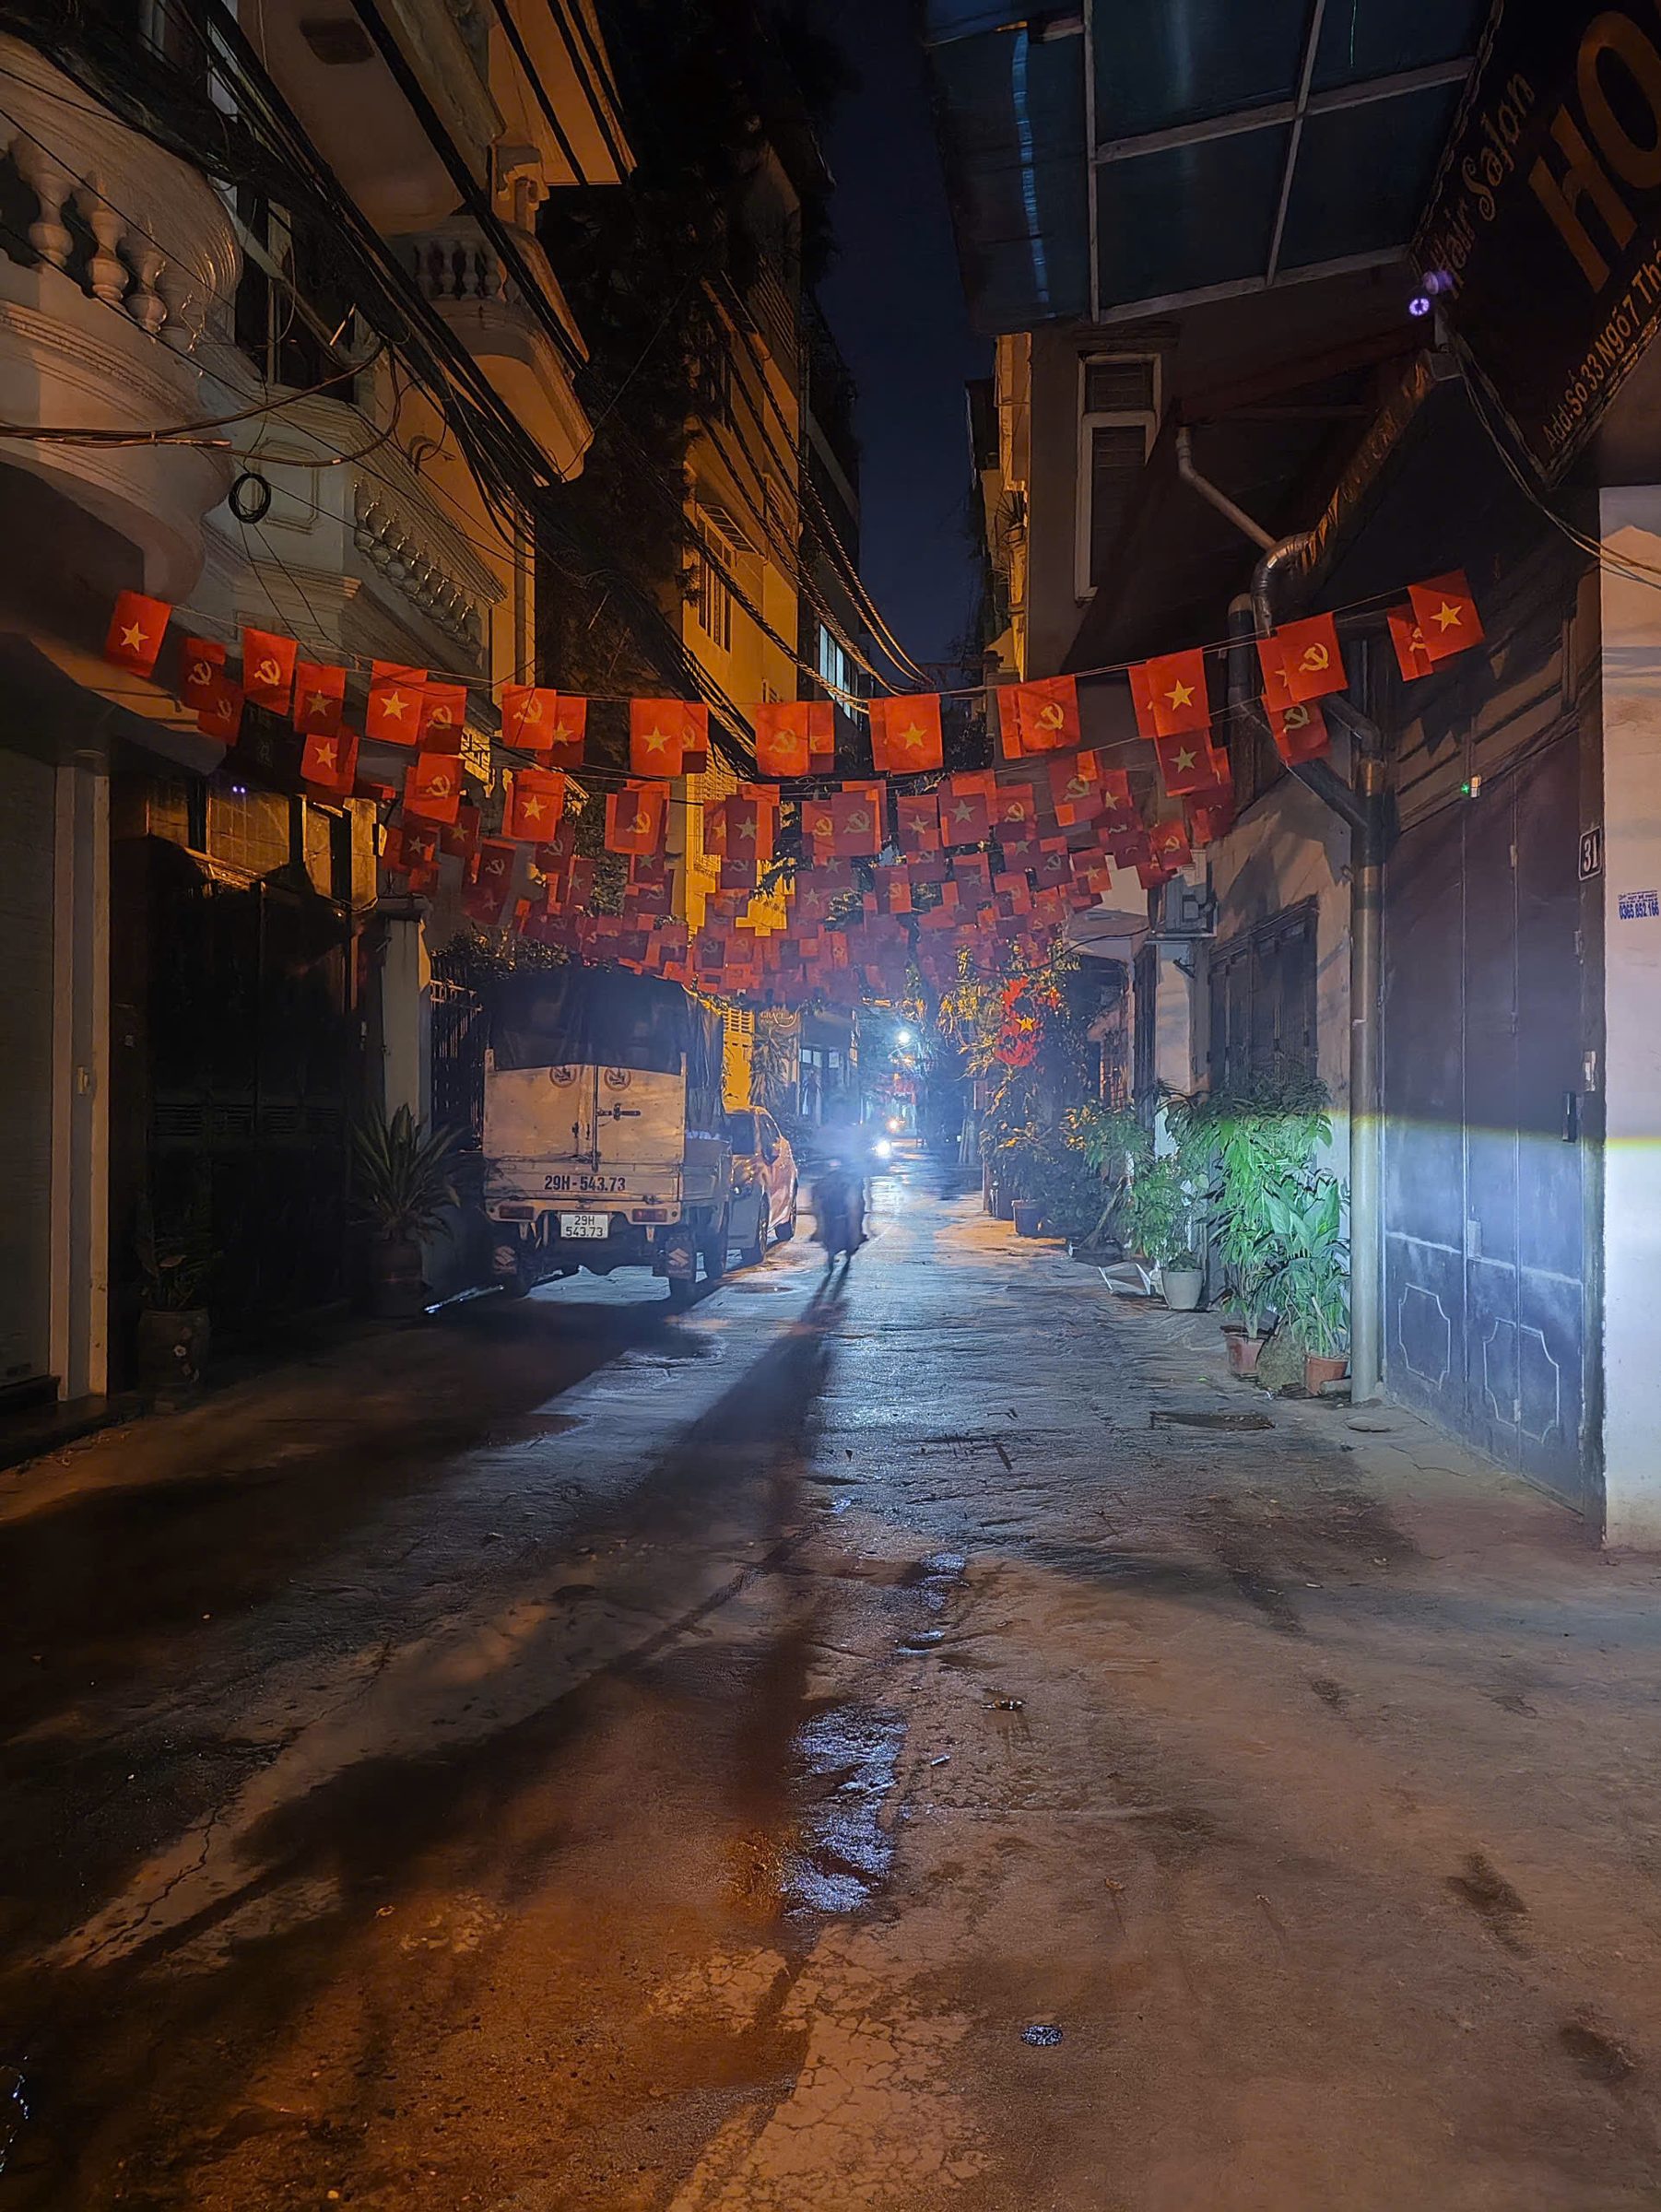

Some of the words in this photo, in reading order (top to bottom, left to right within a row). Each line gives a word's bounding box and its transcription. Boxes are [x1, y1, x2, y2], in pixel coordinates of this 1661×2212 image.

[1526, 0, 1661, 293] HO
[1429, 196, 1476, 300] Hair
[1462, 74, 1535, 221] Salon
[1581, 353, 1605, 391] 33
[1584, 835, 1597, 872] 31
[566, 1226, 603, 1237] 543.73
[574, 1216, 595, 1226] 29H
